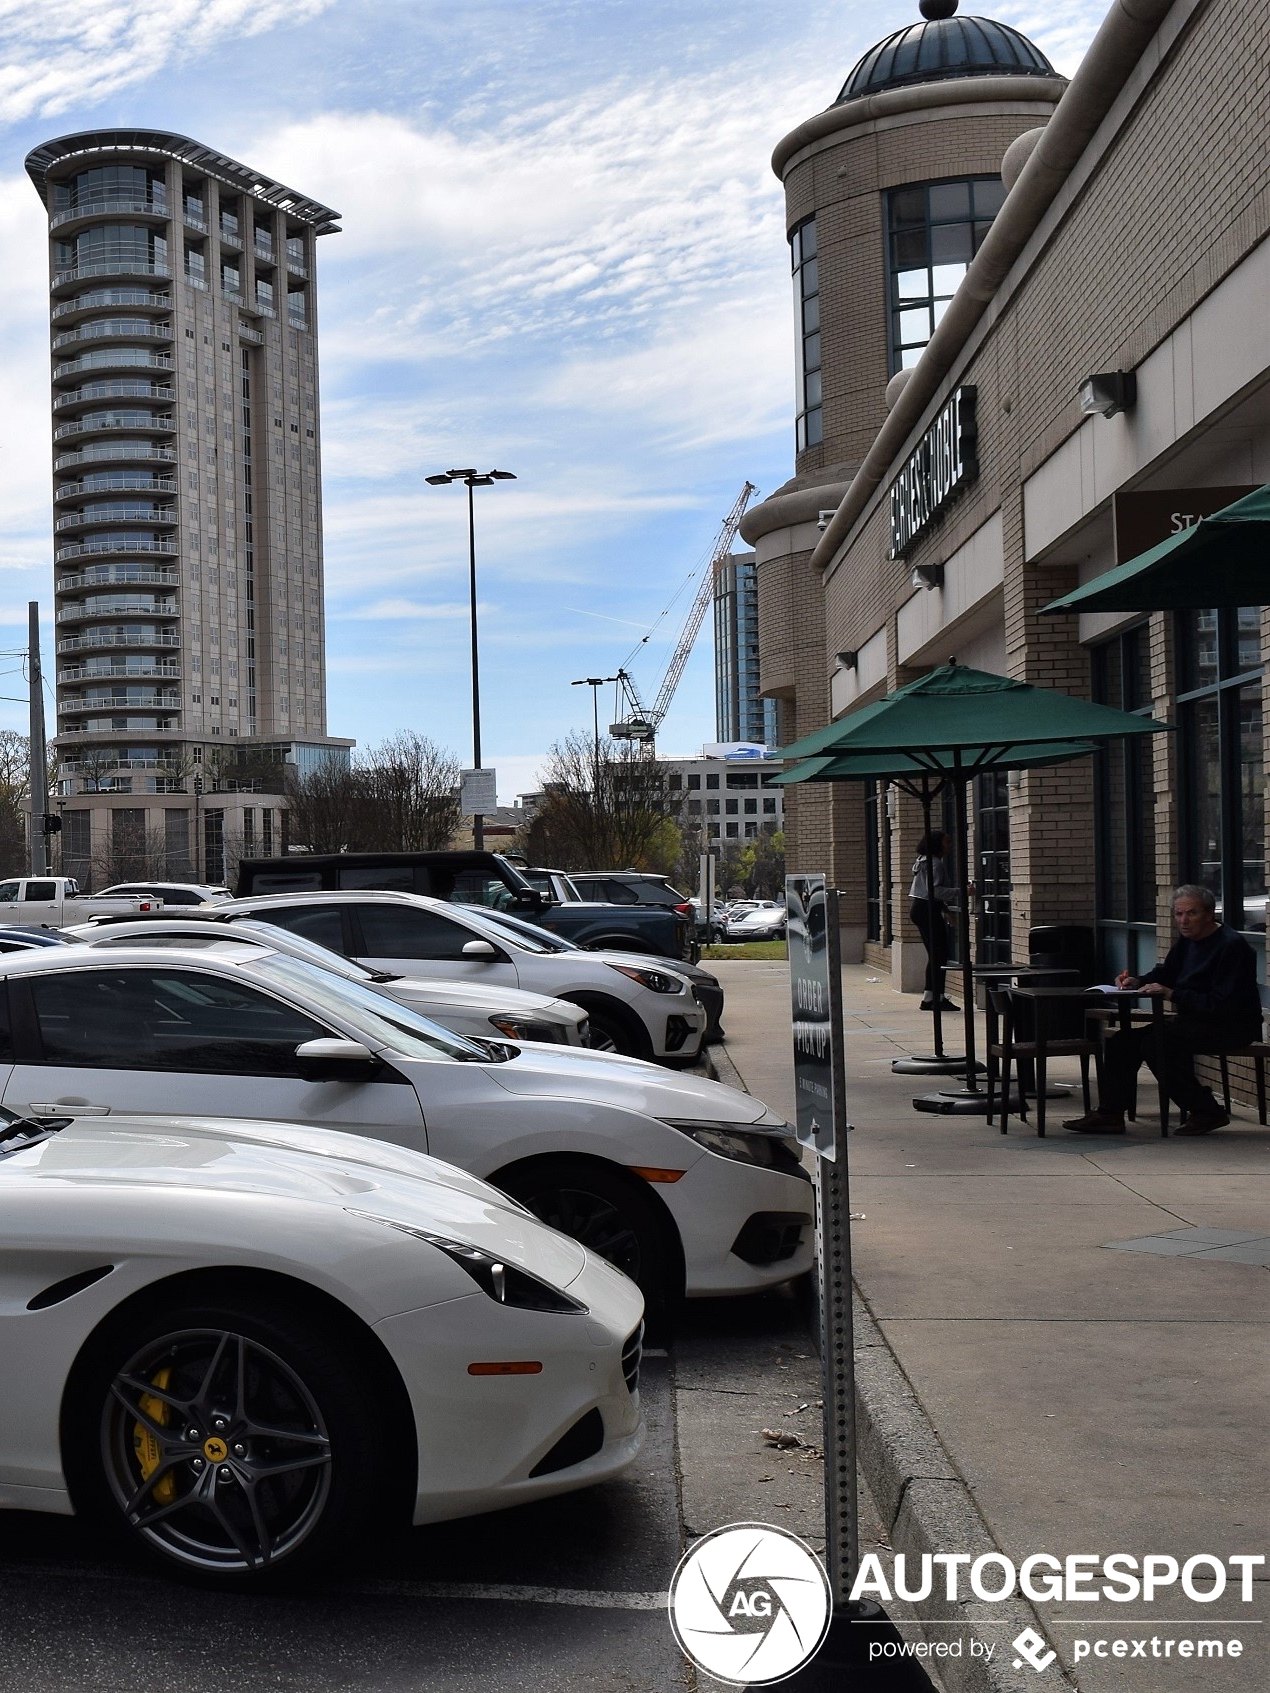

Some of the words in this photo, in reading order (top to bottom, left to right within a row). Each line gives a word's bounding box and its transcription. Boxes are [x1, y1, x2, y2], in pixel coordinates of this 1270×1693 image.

[797, 978, 824, 1014] ORDER
[797, 1020, 815, 1056] PICK
[816, 1026, 827, 1060] UP
